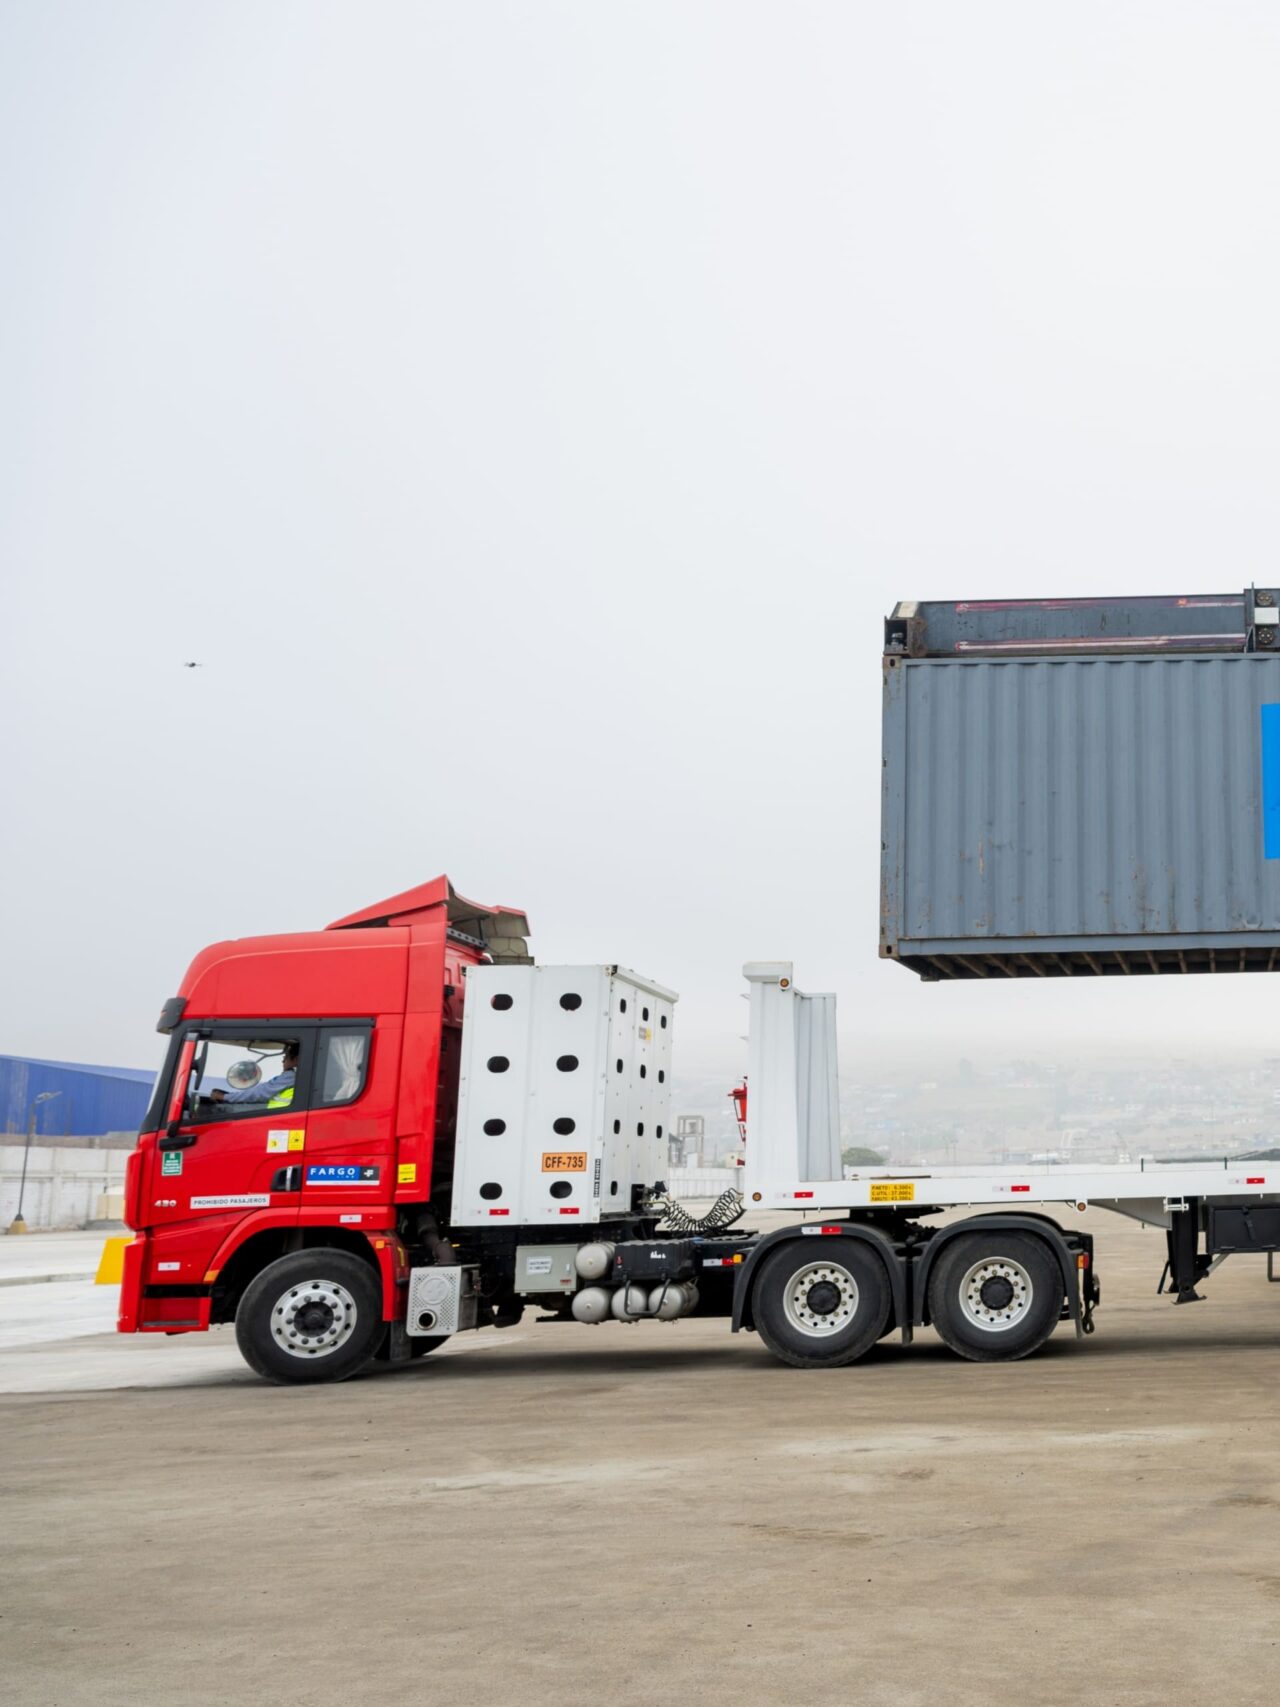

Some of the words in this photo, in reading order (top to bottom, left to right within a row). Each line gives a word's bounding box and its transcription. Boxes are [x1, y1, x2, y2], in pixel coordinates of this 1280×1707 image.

[545, 1156, 584, 1168] CFF-735
[310, 1167, 355, 1176] FARGO
[193, 1198, 229, 1206] PROHIBIDO
